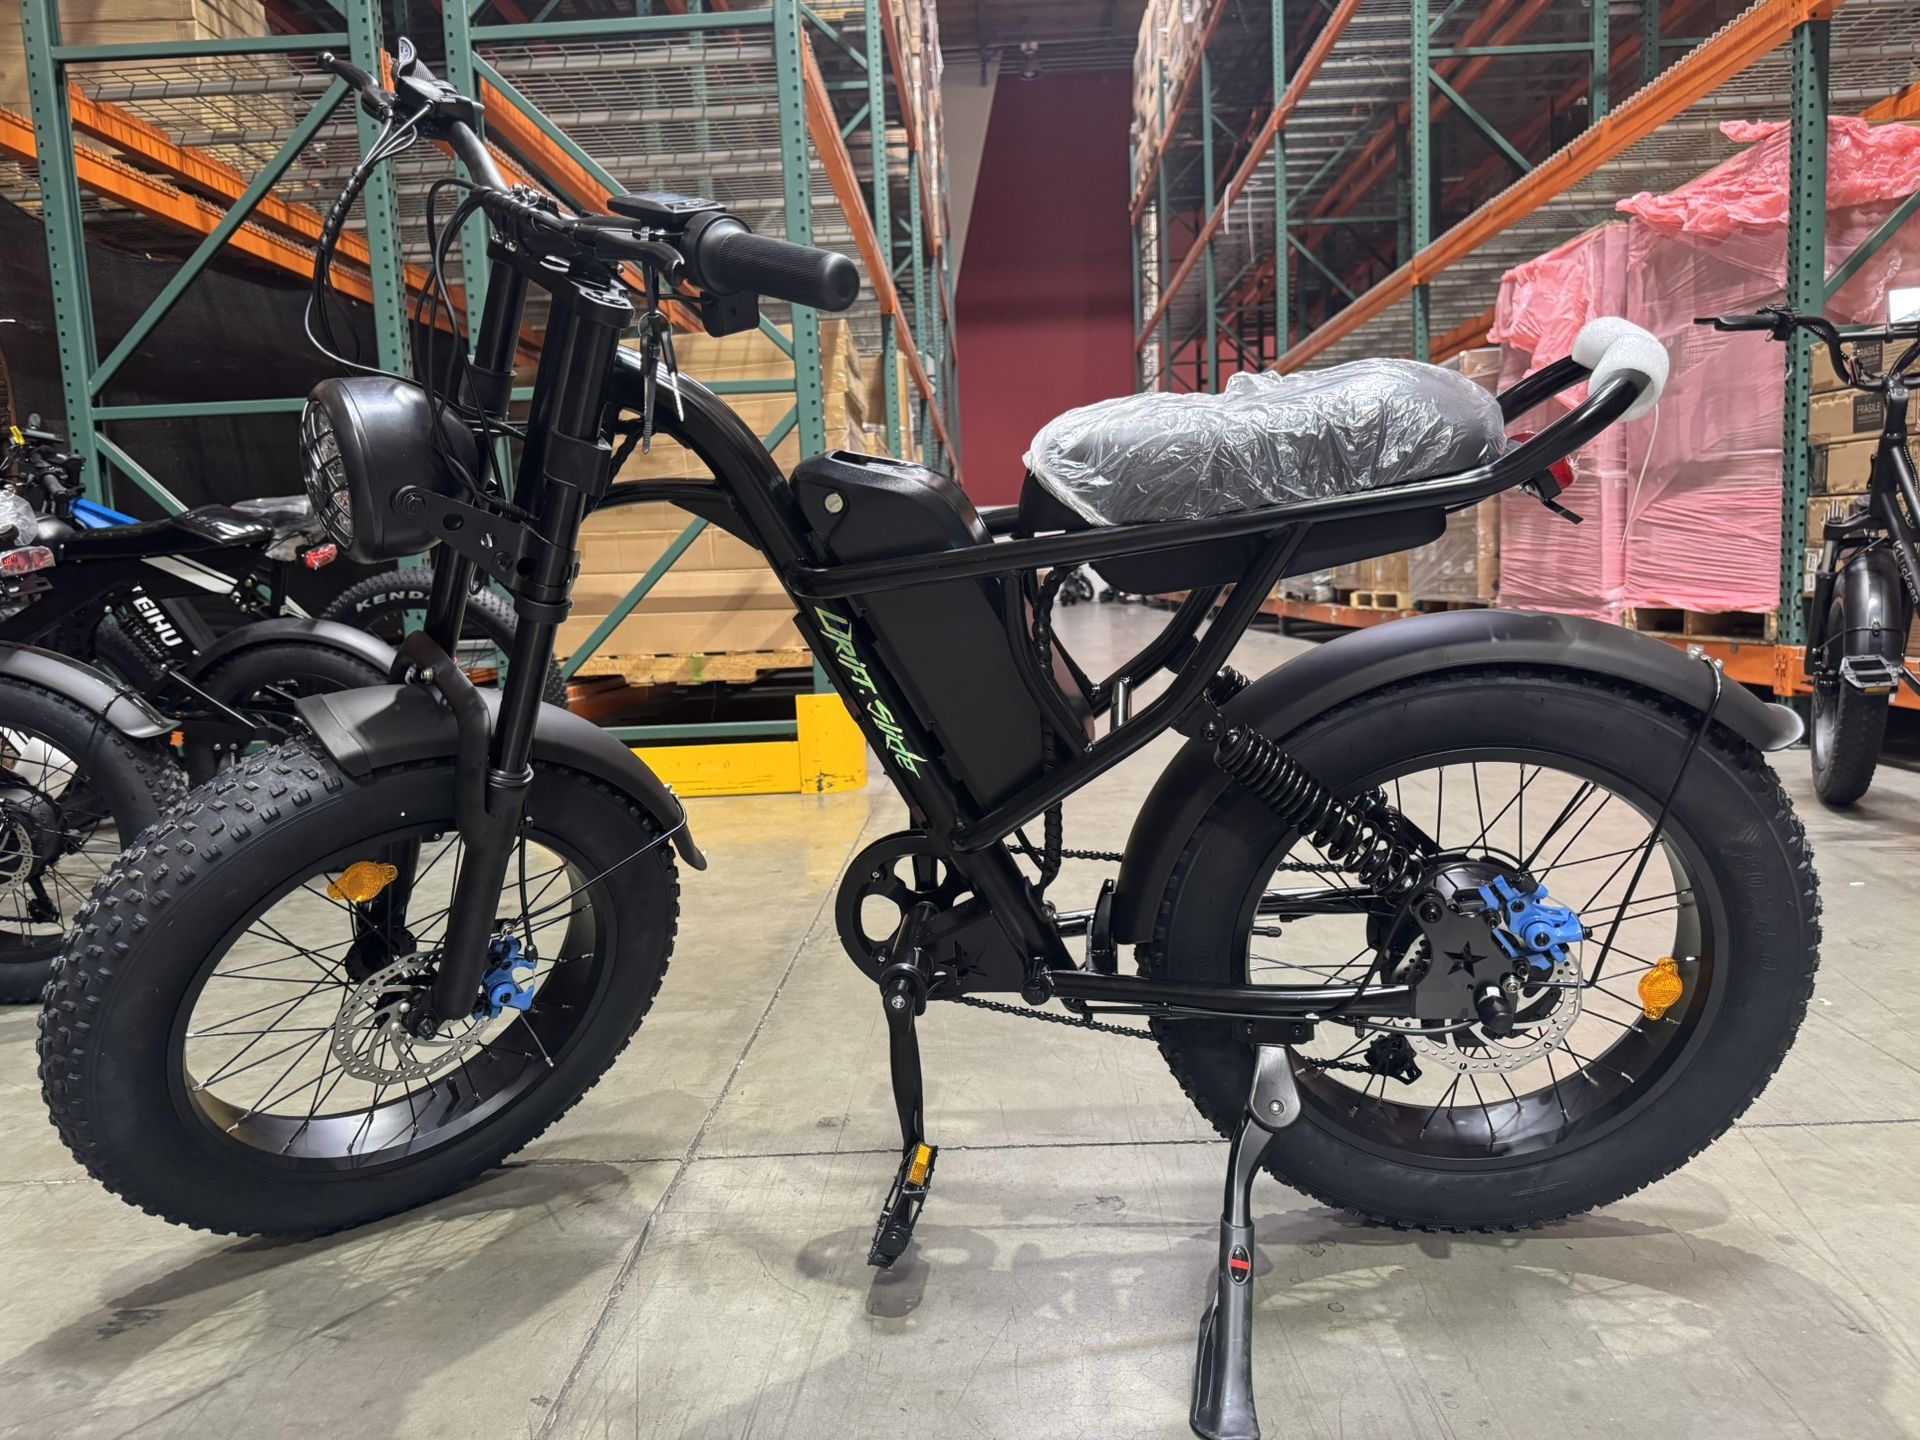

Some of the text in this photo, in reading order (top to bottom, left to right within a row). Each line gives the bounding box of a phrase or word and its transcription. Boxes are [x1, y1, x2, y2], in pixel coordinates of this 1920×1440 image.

[1857, 343, 1880, 357] RAGILE
[1856, 401, 1881, 415] FRAGILE
[355, 590, 430, 613] KEND
